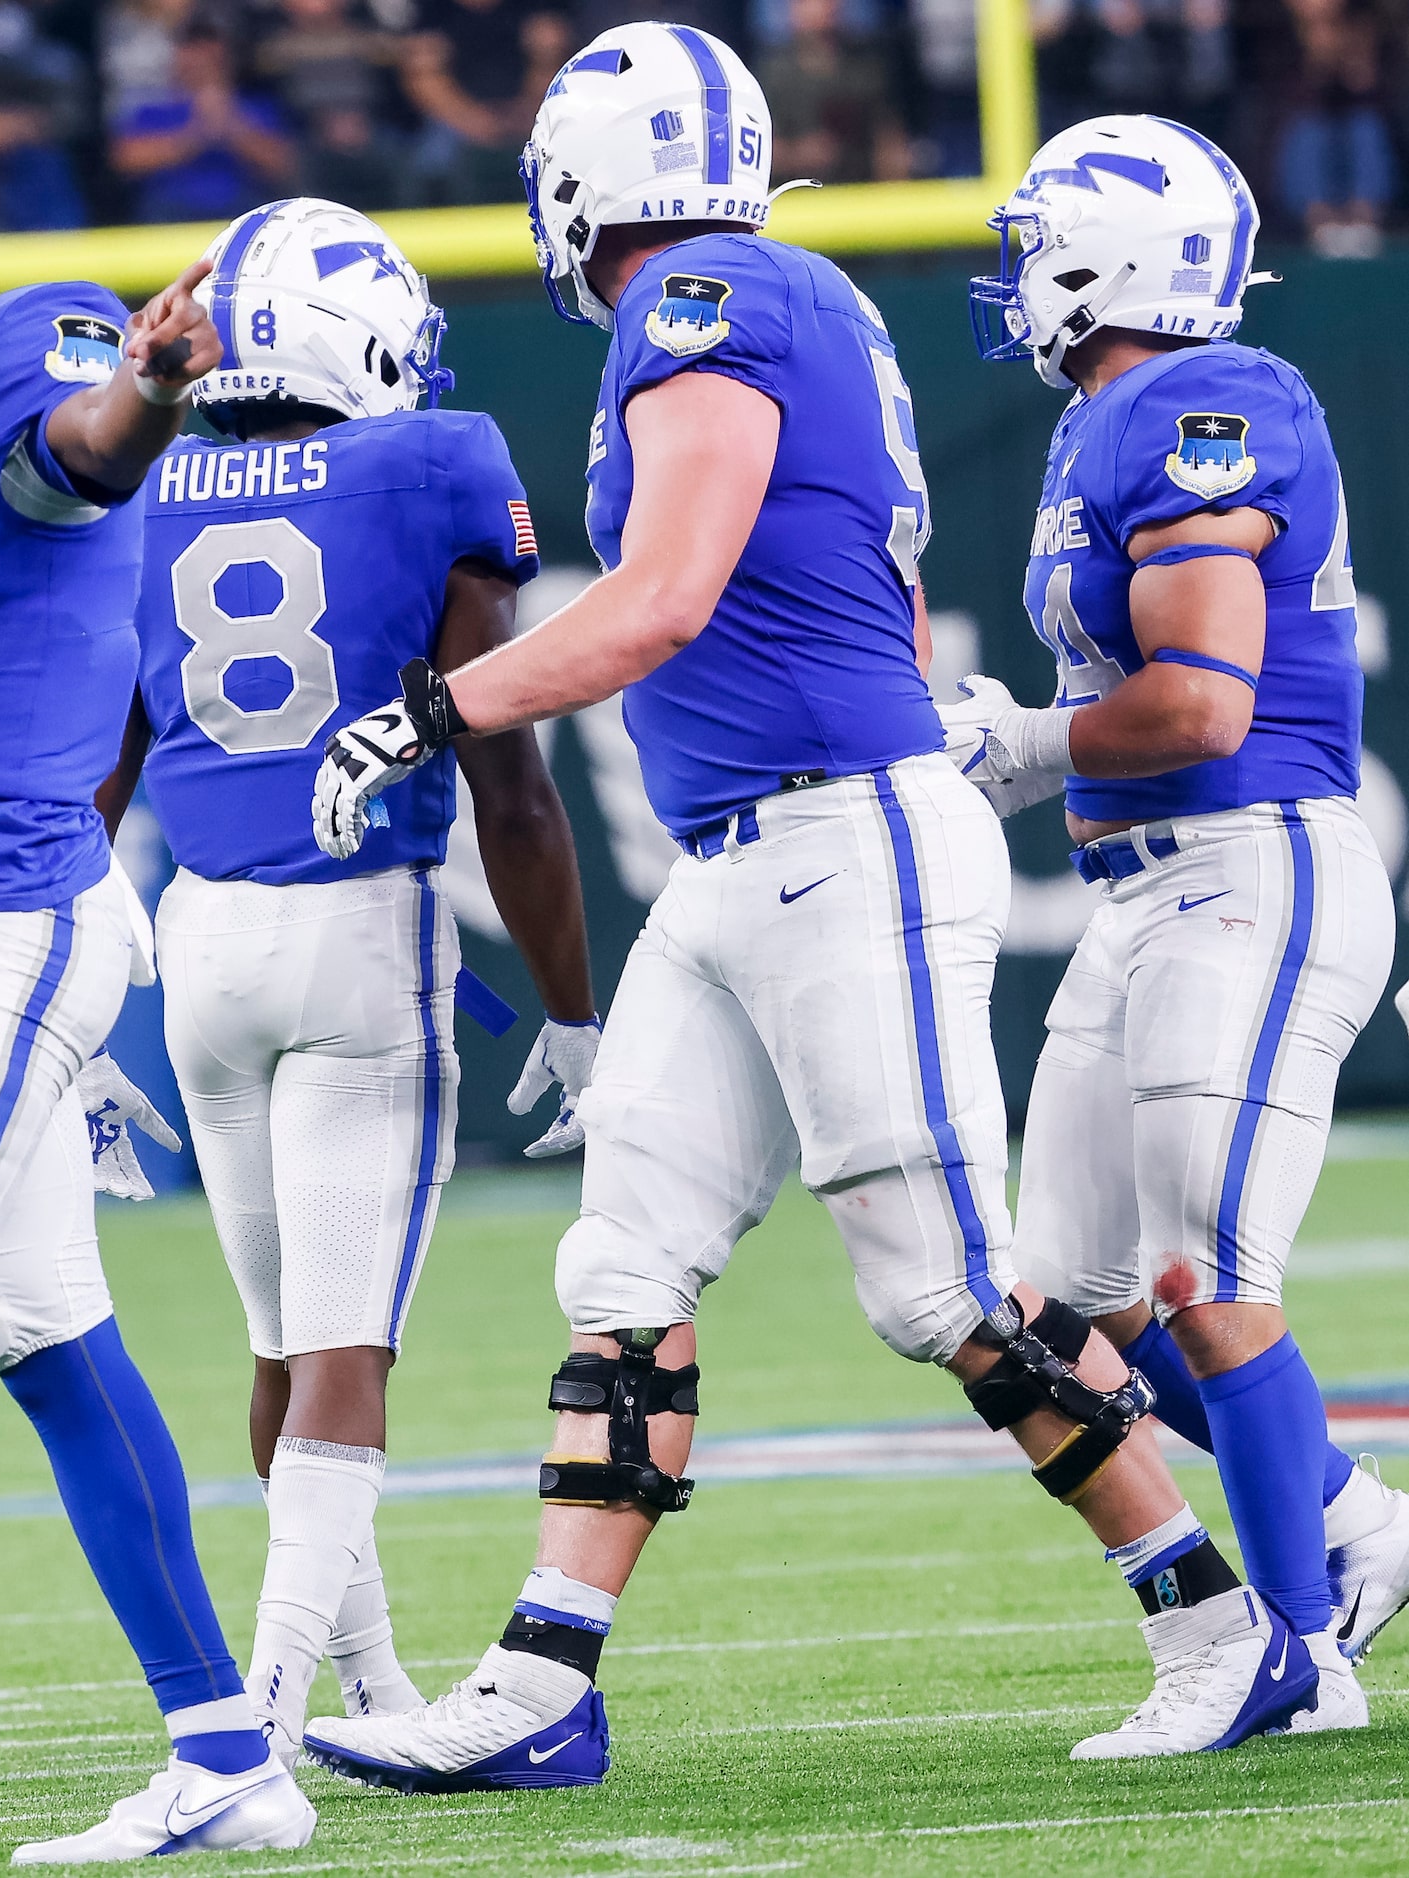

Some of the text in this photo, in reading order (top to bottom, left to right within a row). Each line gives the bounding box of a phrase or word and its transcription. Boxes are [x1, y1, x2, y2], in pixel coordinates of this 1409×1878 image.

[738, 125, 762, 171] 51
[641, 198, 768, 222] AIR FORCE
[251, 309, 276, 346] 8
[1151, 313, 1196, 335] AIR
[219, 375, 286, 391] FORCE
[158, 440, 329, 504] HUGHES
[868, 344, 933, 588] 5
[170, 515, 341, 755] 8
